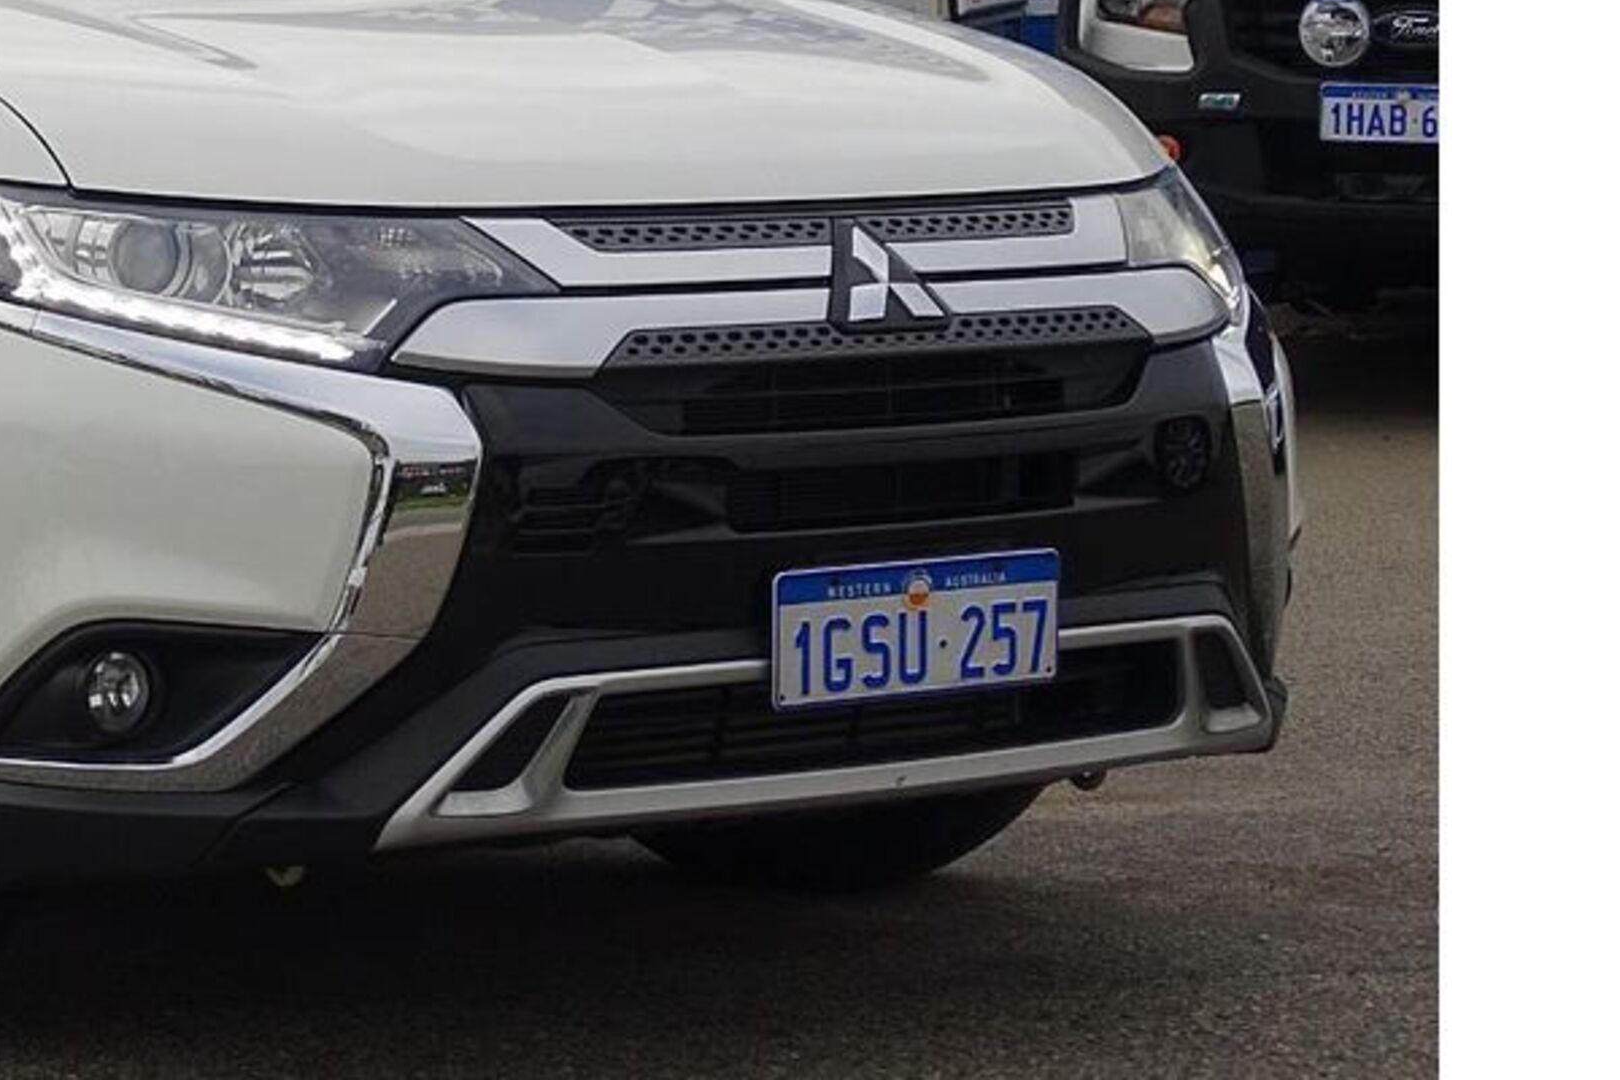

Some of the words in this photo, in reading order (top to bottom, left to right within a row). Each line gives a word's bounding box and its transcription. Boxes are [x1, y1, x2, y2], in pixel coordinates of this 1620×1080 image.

[1392, 15, 1439, 39] For
[828, 583, 891, 598] WESTERN
[944, 572, 1007, 588] AUSTRALIA
